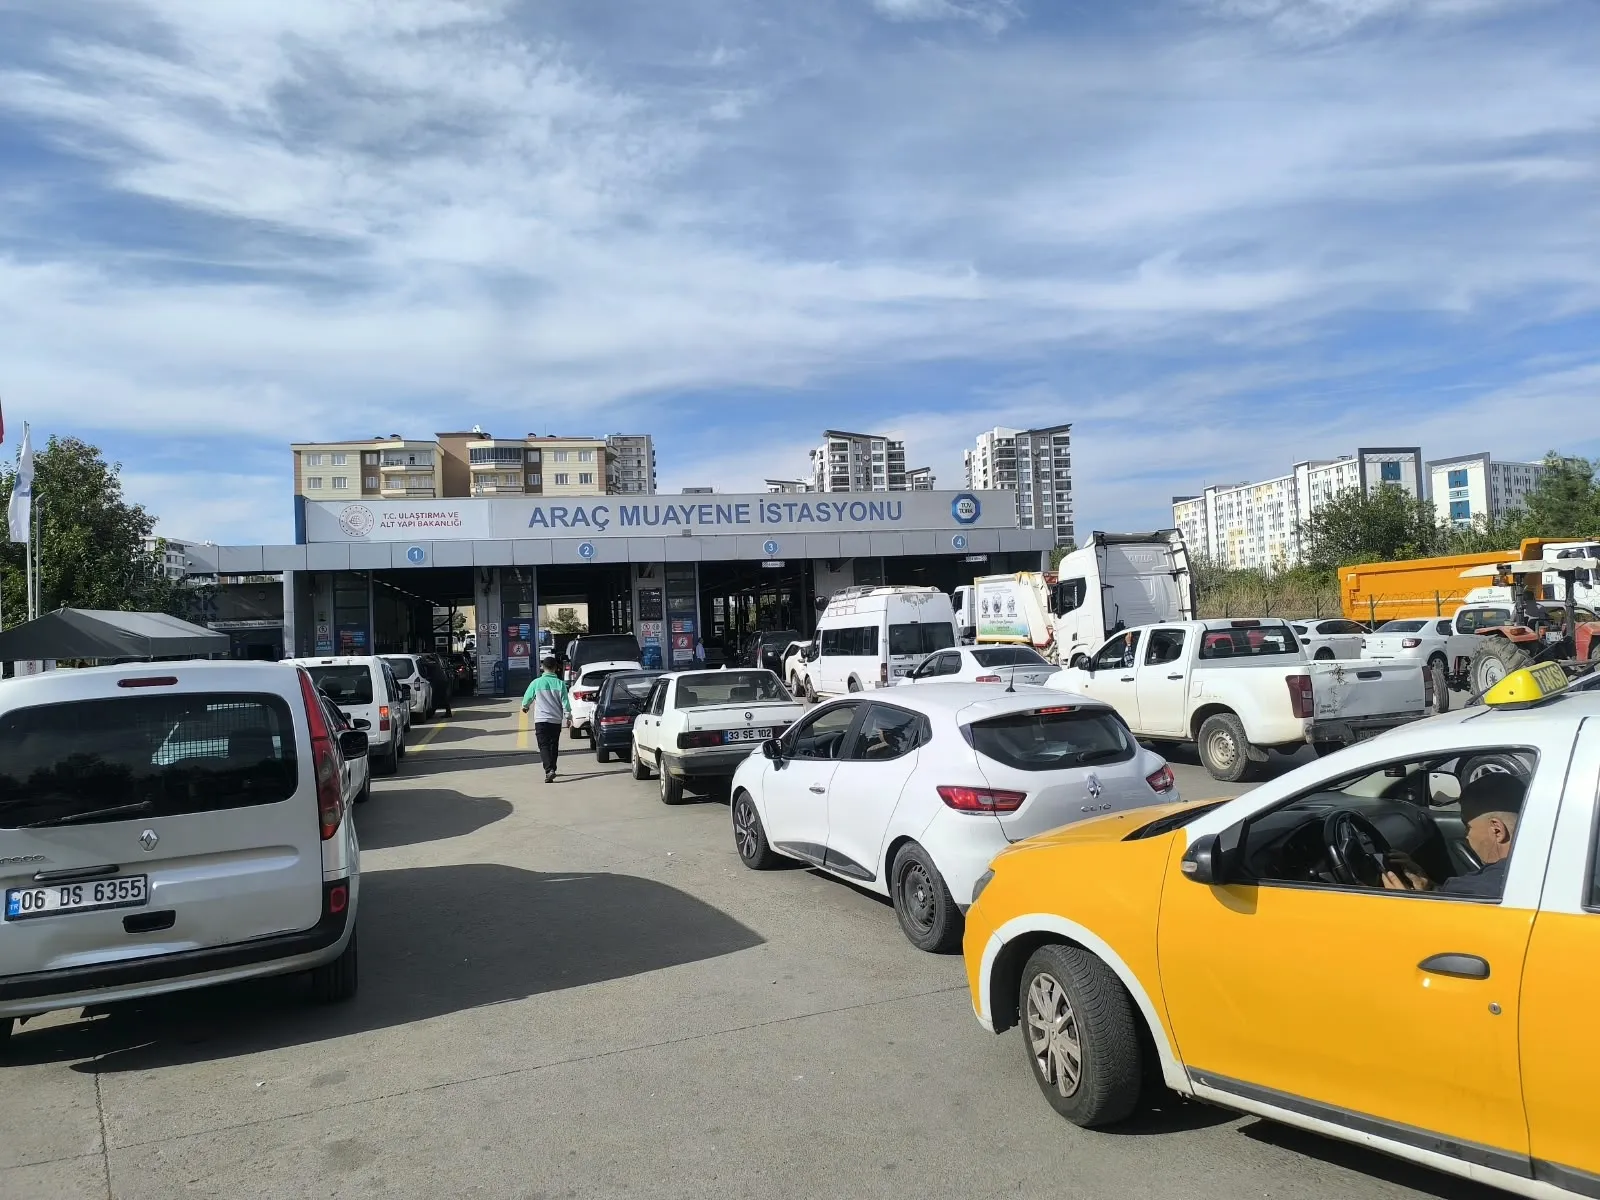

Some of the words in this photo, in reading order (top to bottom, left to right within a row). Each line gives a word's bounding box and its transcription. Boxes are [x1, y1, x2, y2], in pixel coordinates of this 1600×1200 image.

[398, 512, 446, 520] ULAŞTIRMA
[528, 505, 610, 532] ARAÇ
[619, 503, 750, 527] MUAYENE
[759, 499, 902, 524] İSTASYONU
[397, 520, 416, 528] YAPI
[417, 518, 462, 528] BAKANLIĞI
[956, 538, 962, 546] 4
[583, 546, 590, 555] 2
[768, 543, 774, 552] 3
[413, 550, 418, 560] 1
[728, 731, 740, 740] 33
[743, 730, 754, 739] SE
[758, 729, 772, 738] 102
[21, 891, 46, 910] 06
[60, 886, 83, 906] DS
[94, 880, 142, 901] 6355
[9, 903, 20, 911] TR
